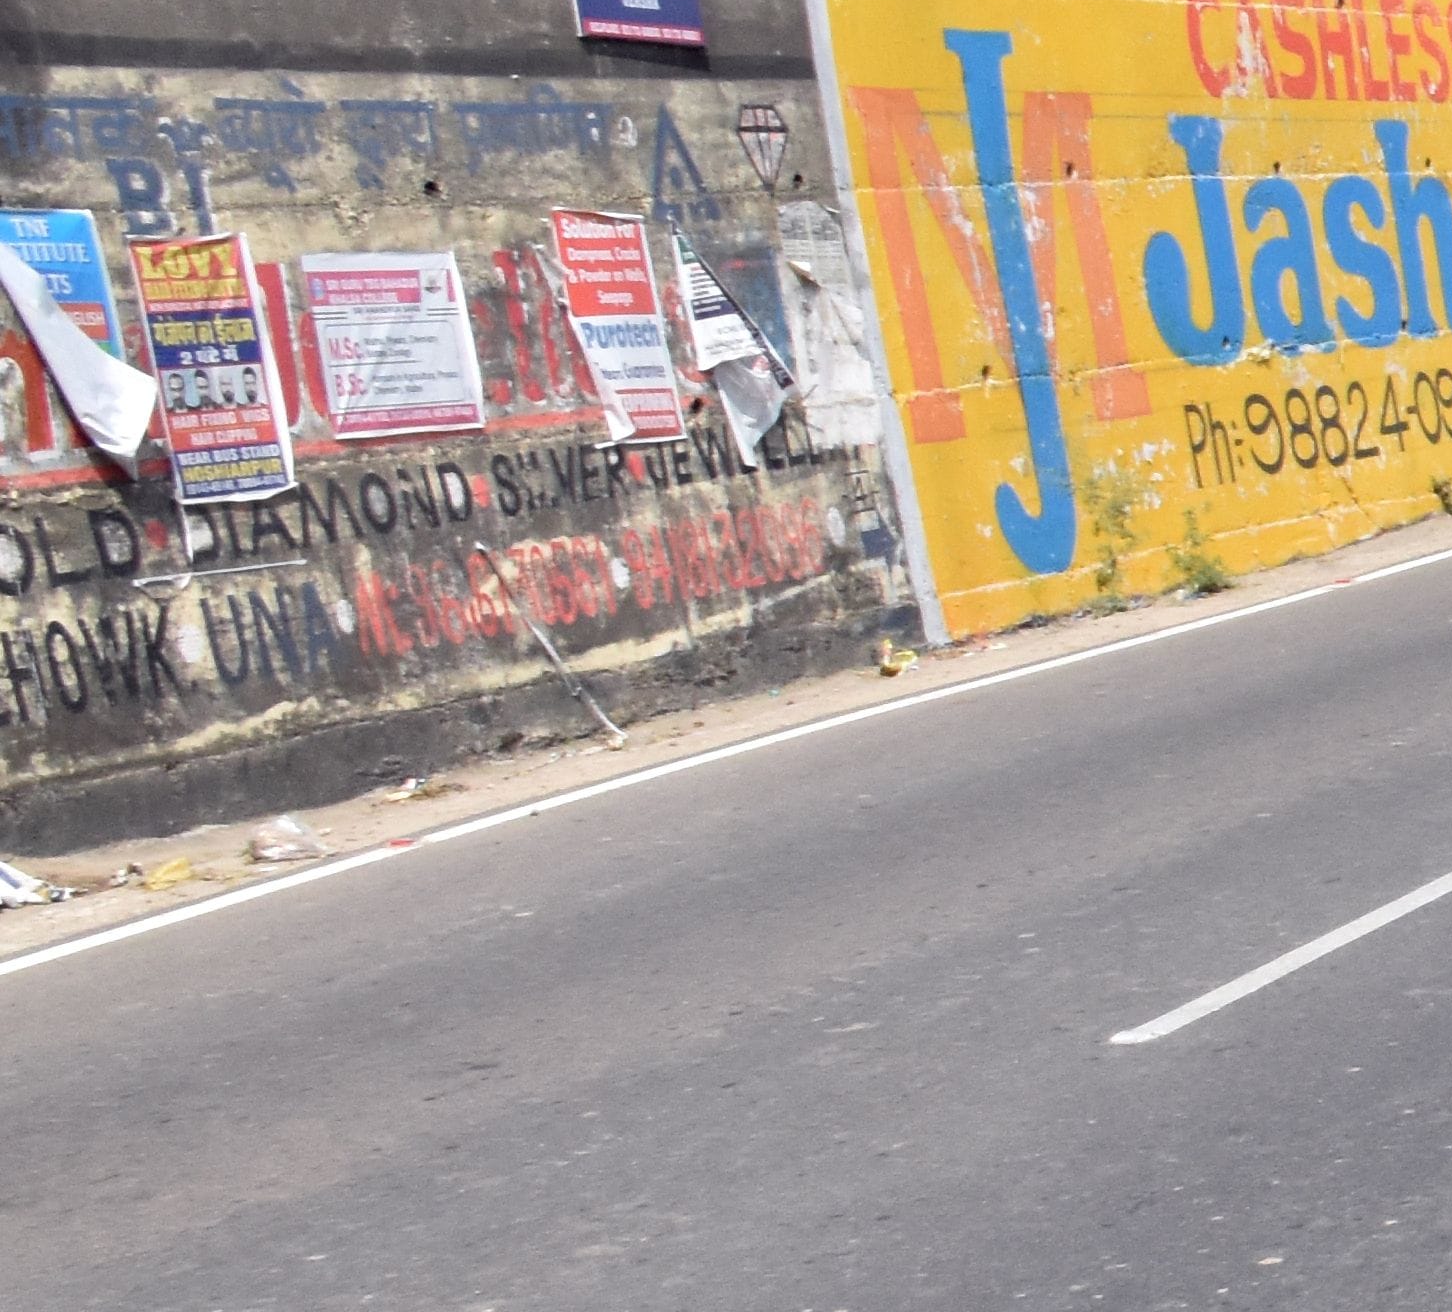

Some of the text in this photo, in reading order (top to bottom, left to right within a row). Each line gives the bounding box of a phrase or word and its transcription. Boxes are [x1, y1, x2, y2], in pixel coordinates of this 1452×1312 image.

[560, 217, 636, 239] Solution For
[10, 242, 91, 263] TITUTE
[134, 242, 238, 279] LOVY
[45, 273, 73, 294] LTS
[580, 321, 662, 349] Purotech
[172, 413, 200, 429] HAIR
[179, 450, 211, 466] NEAR
[240, 443, 280, 460] STAND
[182, 458, 282, 484] HOSHIARPUR
[0, 507, 142, 596] OLD
[190, 462, 473, 565] DIAMOND
[0, 598, 186, 724] HOWK
[202, 580, 339, 687] UNA
